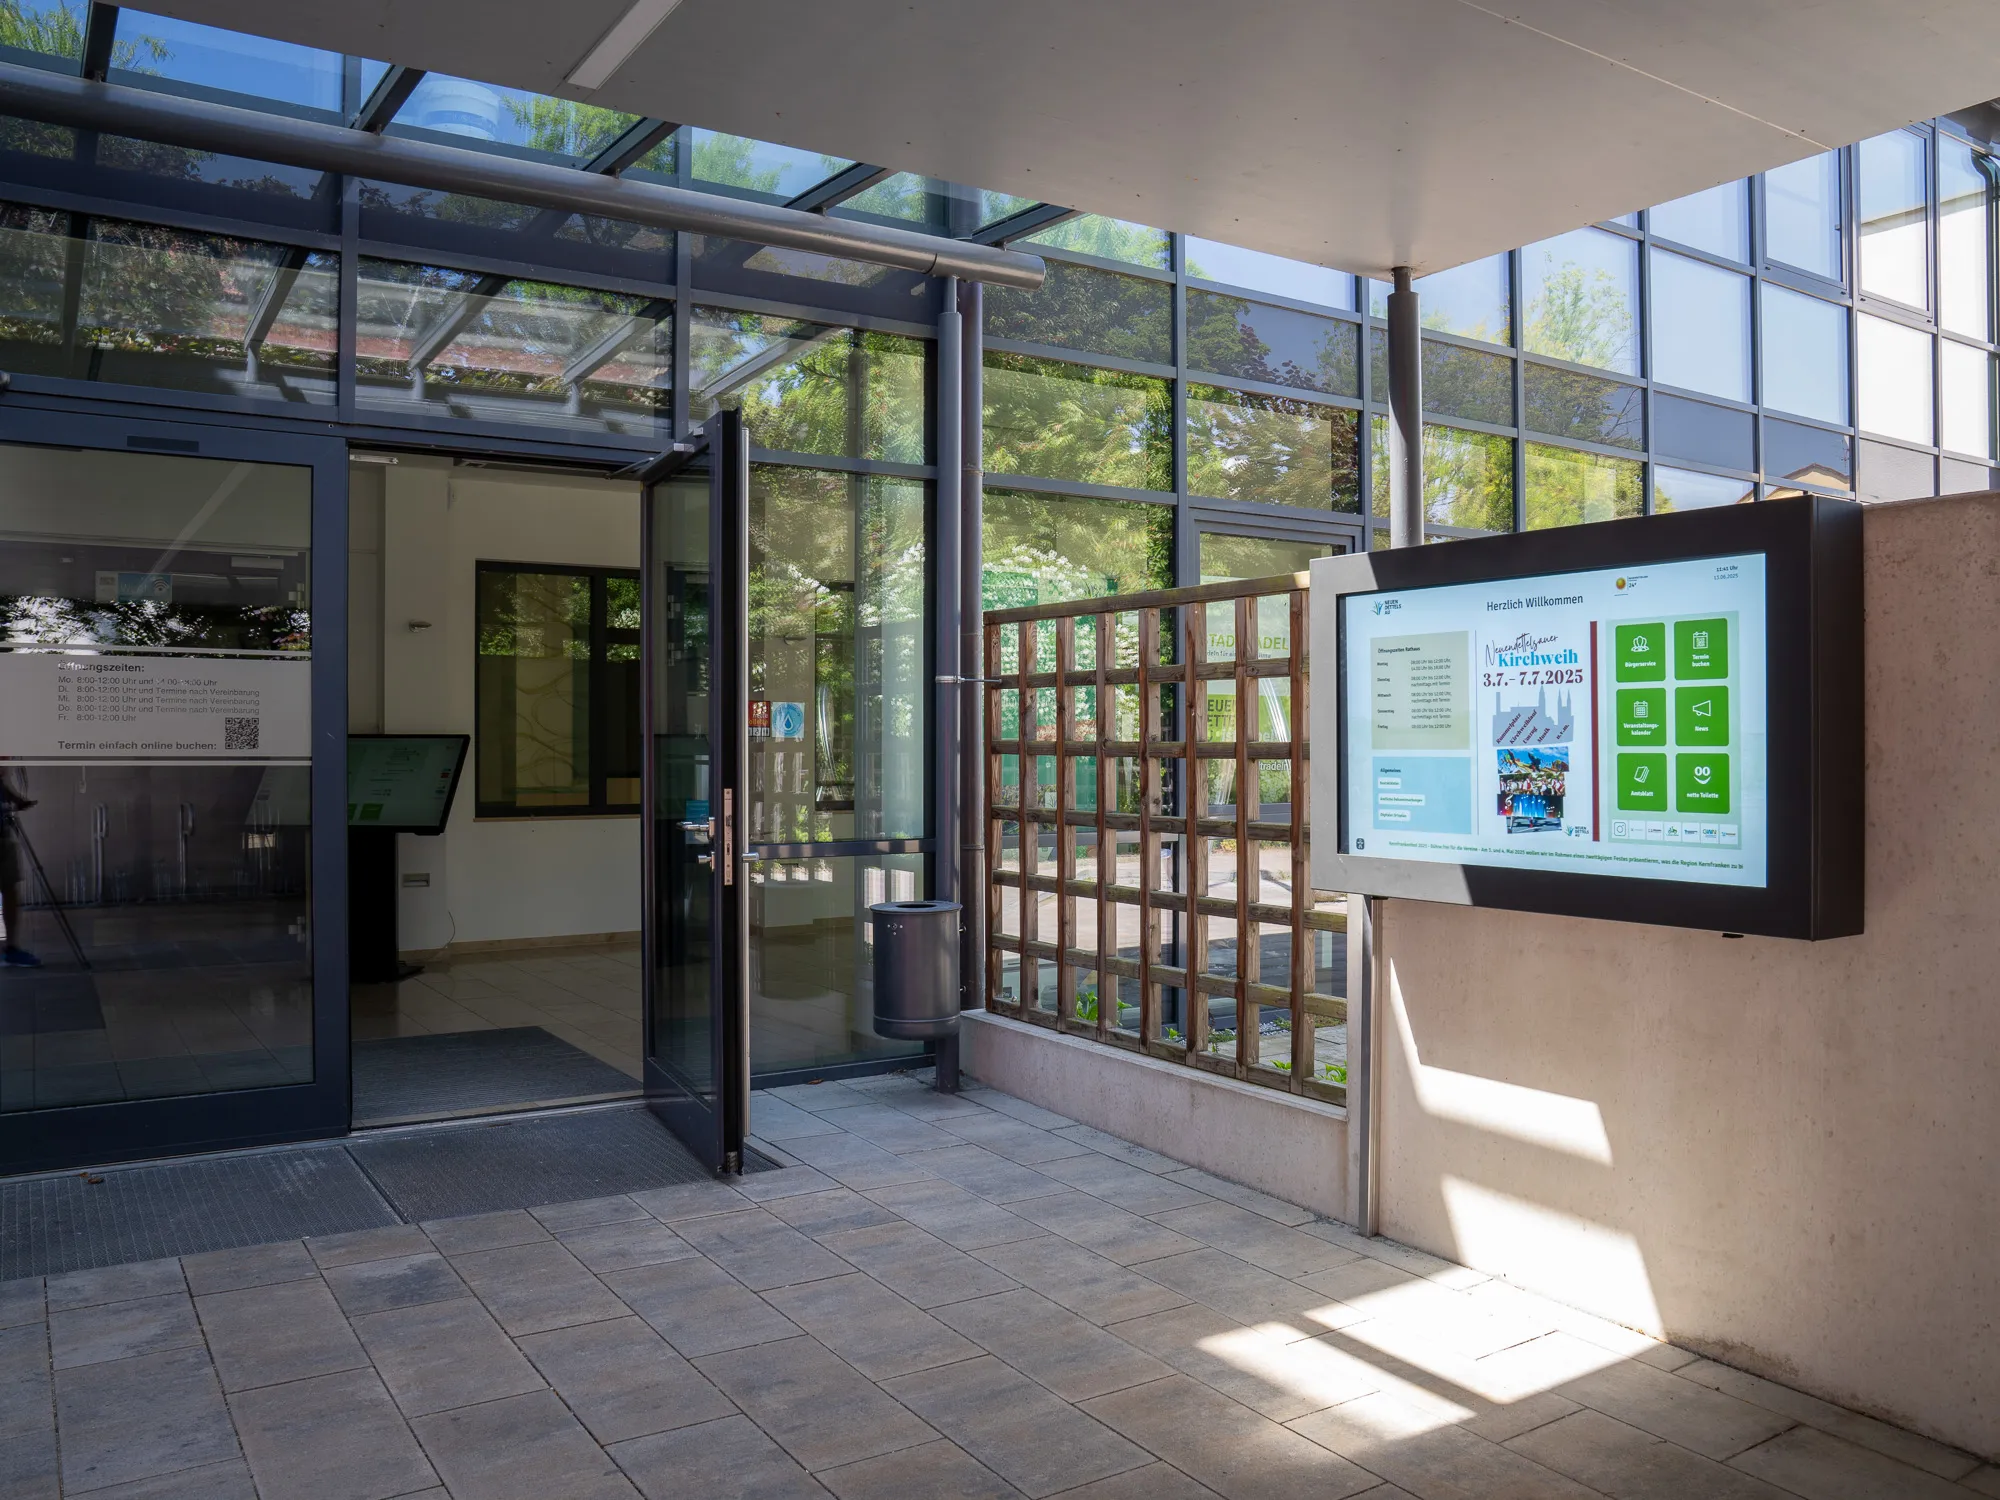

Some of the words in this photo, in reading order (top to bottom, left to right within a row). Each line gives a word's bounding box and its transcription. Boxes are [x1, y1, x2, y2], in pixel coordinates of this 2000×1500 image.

[1487, 598, 1523, 611] Herzlich
[1525, 595, 1584, 608] Willkommen
[1498, 649, 1578, 667] Kirchweih
[58, 660, 145, 673] Öffnungszeiten:
[58, 676, 73, 684] Mo.
[76, 676, 120, 684] 8:00-12:00
[122, 677, 136, 685] Uhr
[1519, 669, 1583, 685] 7.7.2025
[58, 685, 70, 693] Di.
[76, 686, 120, 694] 8:00-12:00
[155, 687, 187, 695] Termine
[209, 688, 260, 697] Vereinbarung
[76, 695, 120, 703] 8:00-12:00
[138, 696, 154, 704] und
[155, 696, 187, 704] Termine
[209, 698, 260, 707] Vereinbarung
[58, 704, 72, 712] Do.
[76, 704, 120, 712] 8:00-12:00
[138, 705, 154, 713] und
[209, 706, 260, 716] Vereinbarung
[1496, 713, 1521, 744] Rummelplatz
[1509, 709, 1537, 744] Kirchweihlauf
[1556, 724, 1570, 740] u.v.m.
[1523, 726, 1538, 744] Umzug
[1537, 727, 1550, 743] Musik
[58, 741, 95, 750] Termin
[98, 741, 138, 750] einfach
[141, 742, 172, 750] online
[175, 741, 217, 751] buchen:
[1585, 854, 1612, 862] zweitägigen
[1629, 857, 1661, 865] präsentieren,
[1698, 861, 1730, 869] Kernfranken
